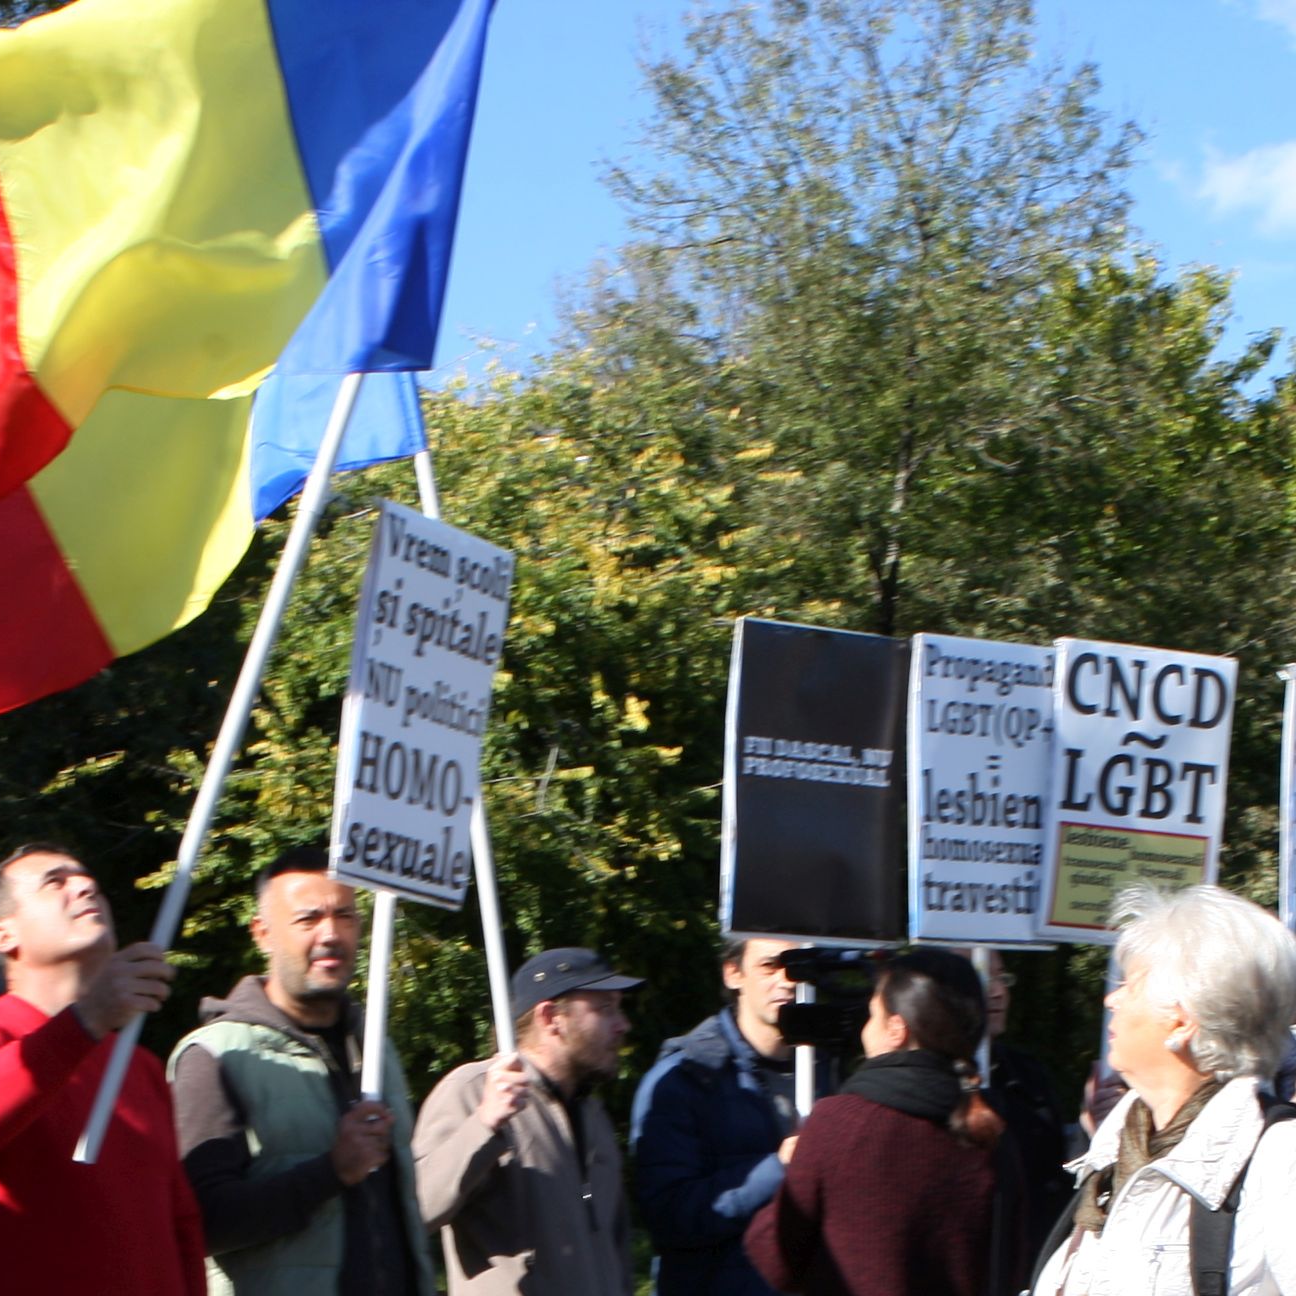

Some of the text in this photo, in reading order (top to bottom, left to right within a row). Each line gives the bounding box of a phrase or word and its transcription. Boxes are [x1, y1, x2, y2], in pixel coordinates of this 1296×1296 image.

[388, 513, 452, 578] Vrem
[405, 597, 499, 666] spitale
[365, 658, 404, 707] NU
[1067, 652, 1228, 730] CNCD
[355, 731, 474, 817] HOMO-
[1059, 747, 1218, 825] LGBT
[343, 822, 468, 890] sexuale
[922, 870, 1041, 916] travesti
